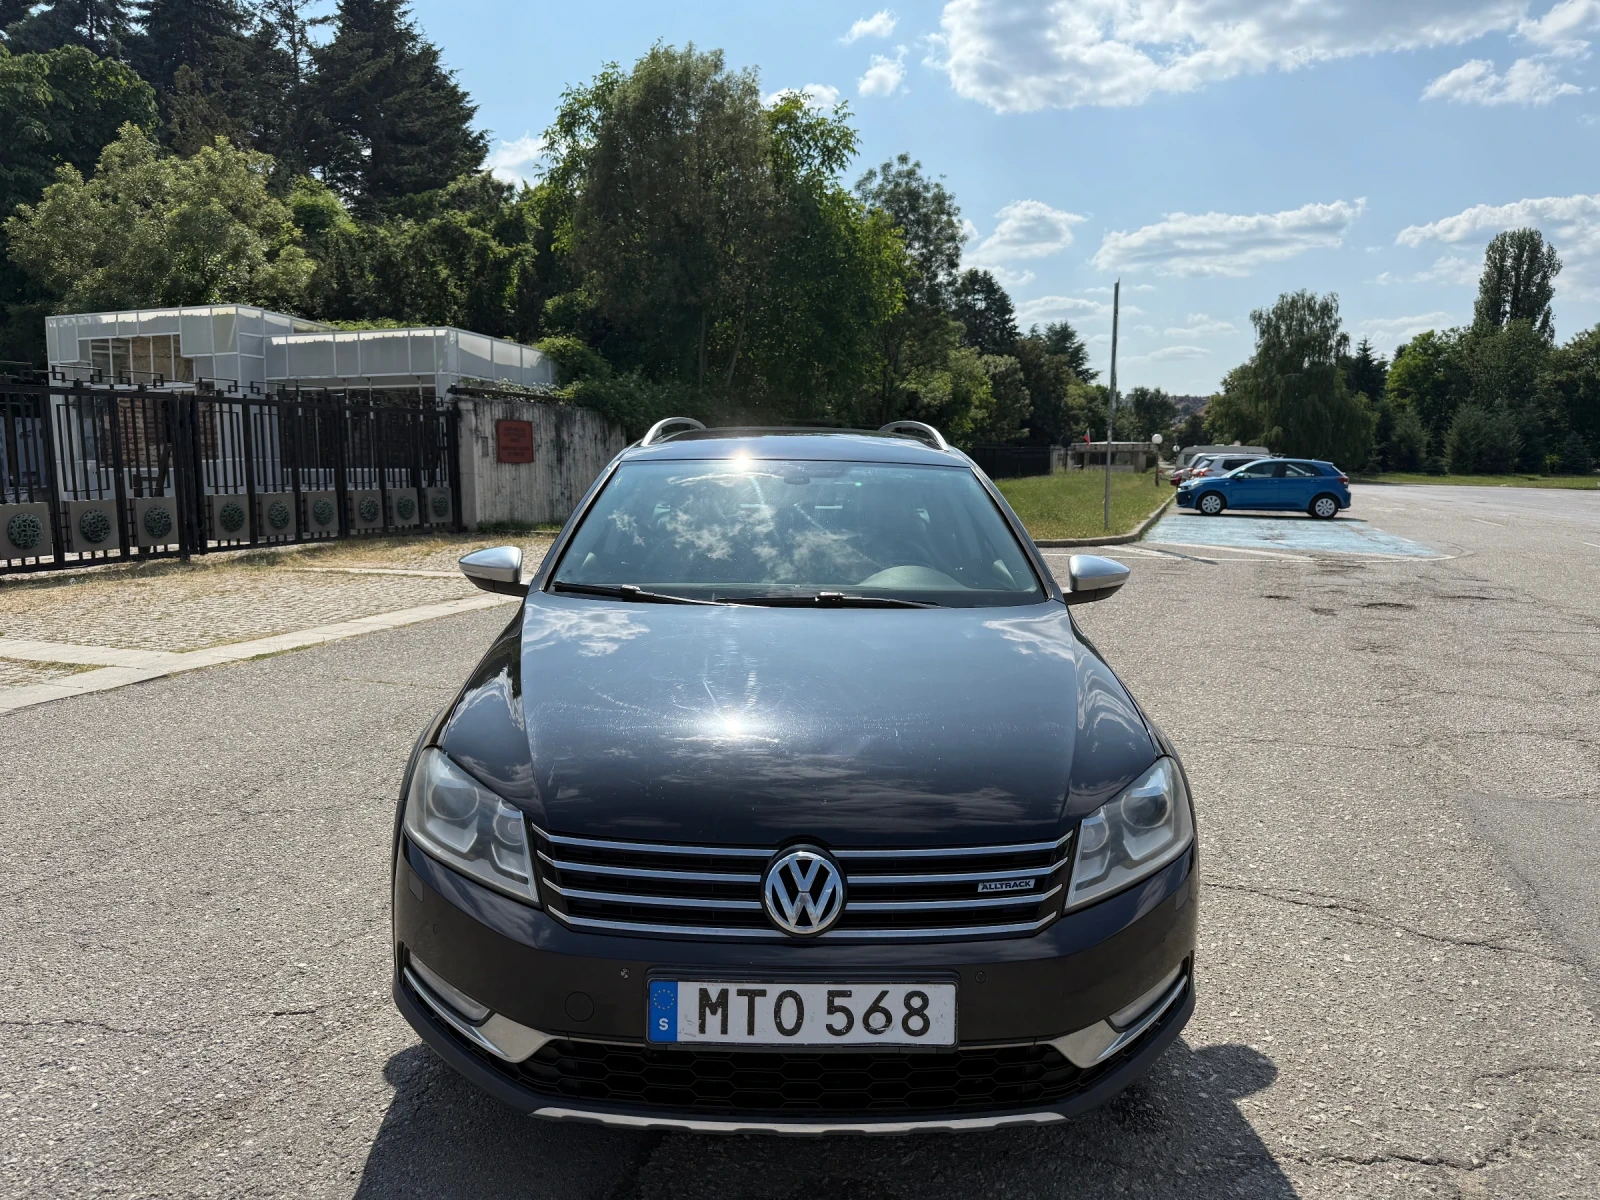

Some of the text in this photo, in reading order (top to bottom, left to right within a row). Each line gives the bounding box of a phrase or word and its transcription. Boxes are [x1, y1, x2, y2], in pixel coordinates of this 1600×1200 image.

[766, 852, 843, 933] VW
[981, 881, 1031, 890] ALLTRACK
[658, 1018, 669, 1031] S
[698, 988, 931, 1037] MTO 568
